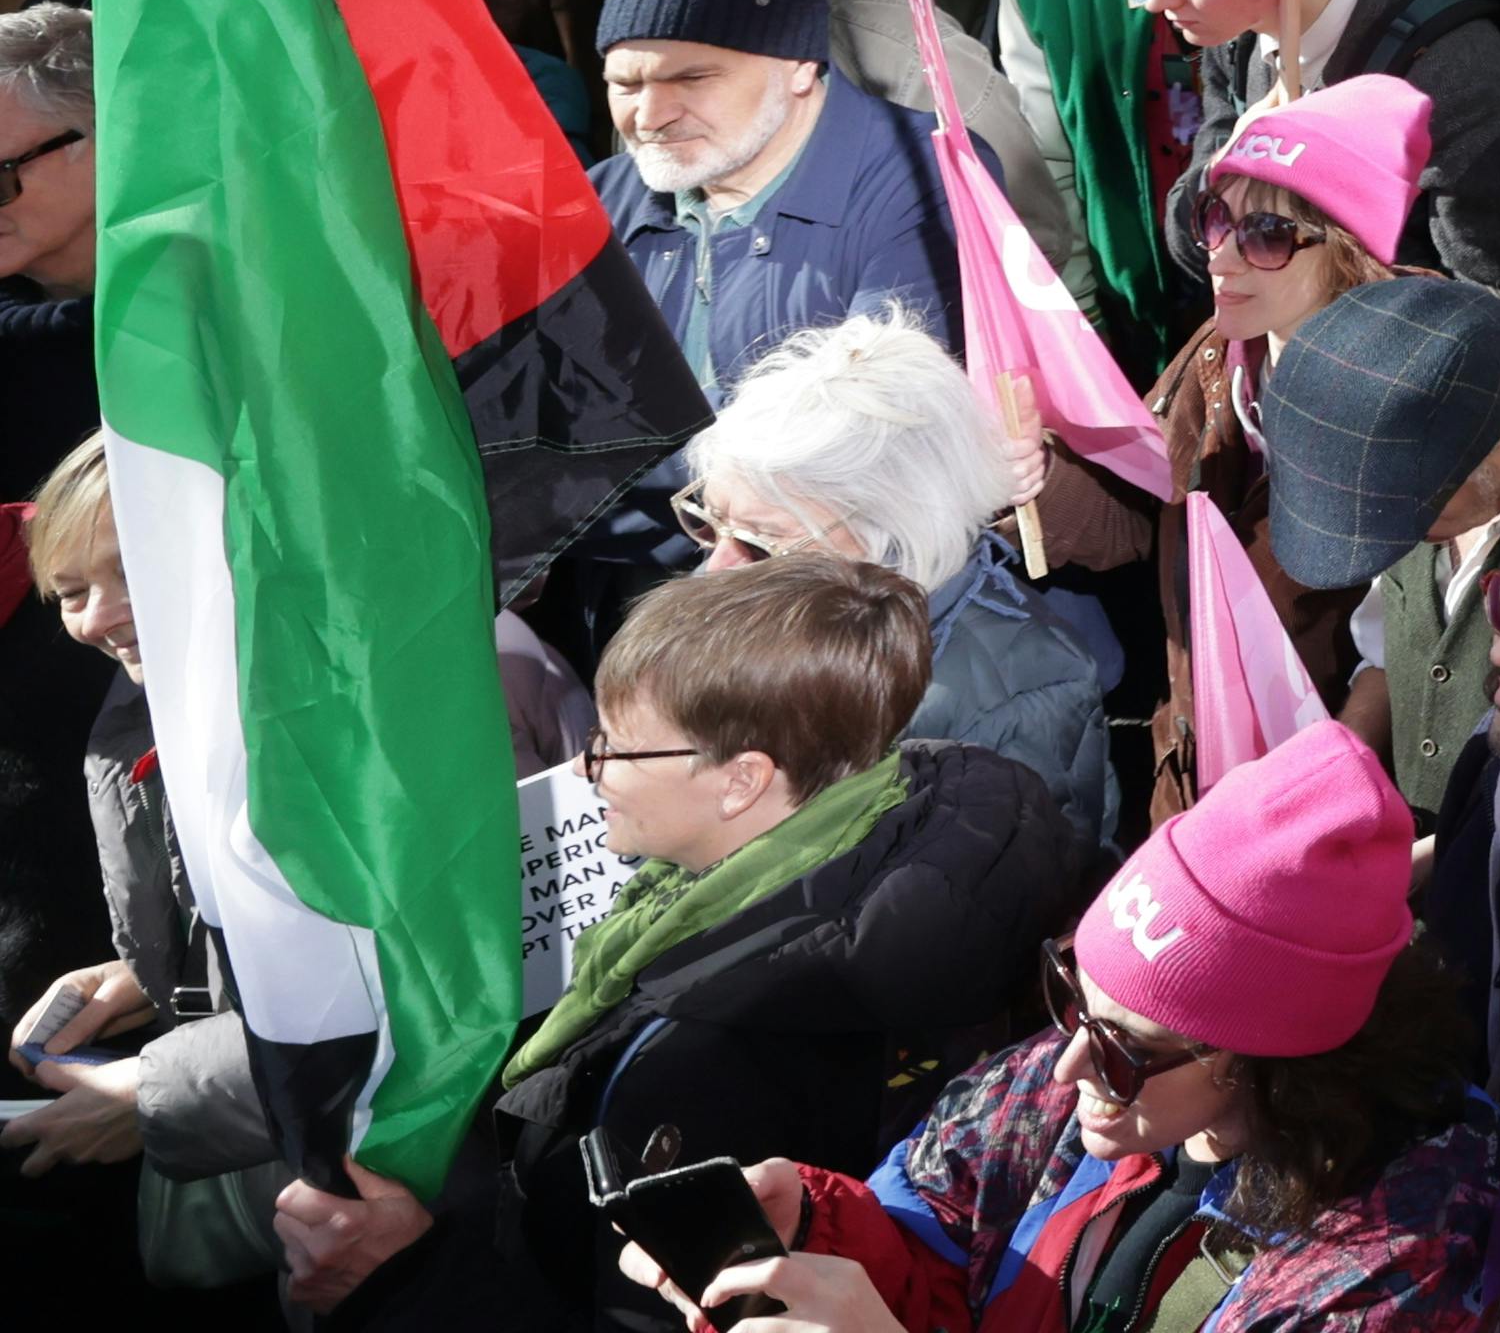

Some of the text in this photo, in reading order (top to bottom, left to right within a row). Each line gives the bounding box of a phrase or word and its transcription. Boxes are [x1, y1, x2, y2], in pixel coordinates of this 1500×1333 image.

[1231, 132, 1306, 168] UCU
[530, 861, 605, 904] MAN
[1106, 866, 1180, 964] UCU
